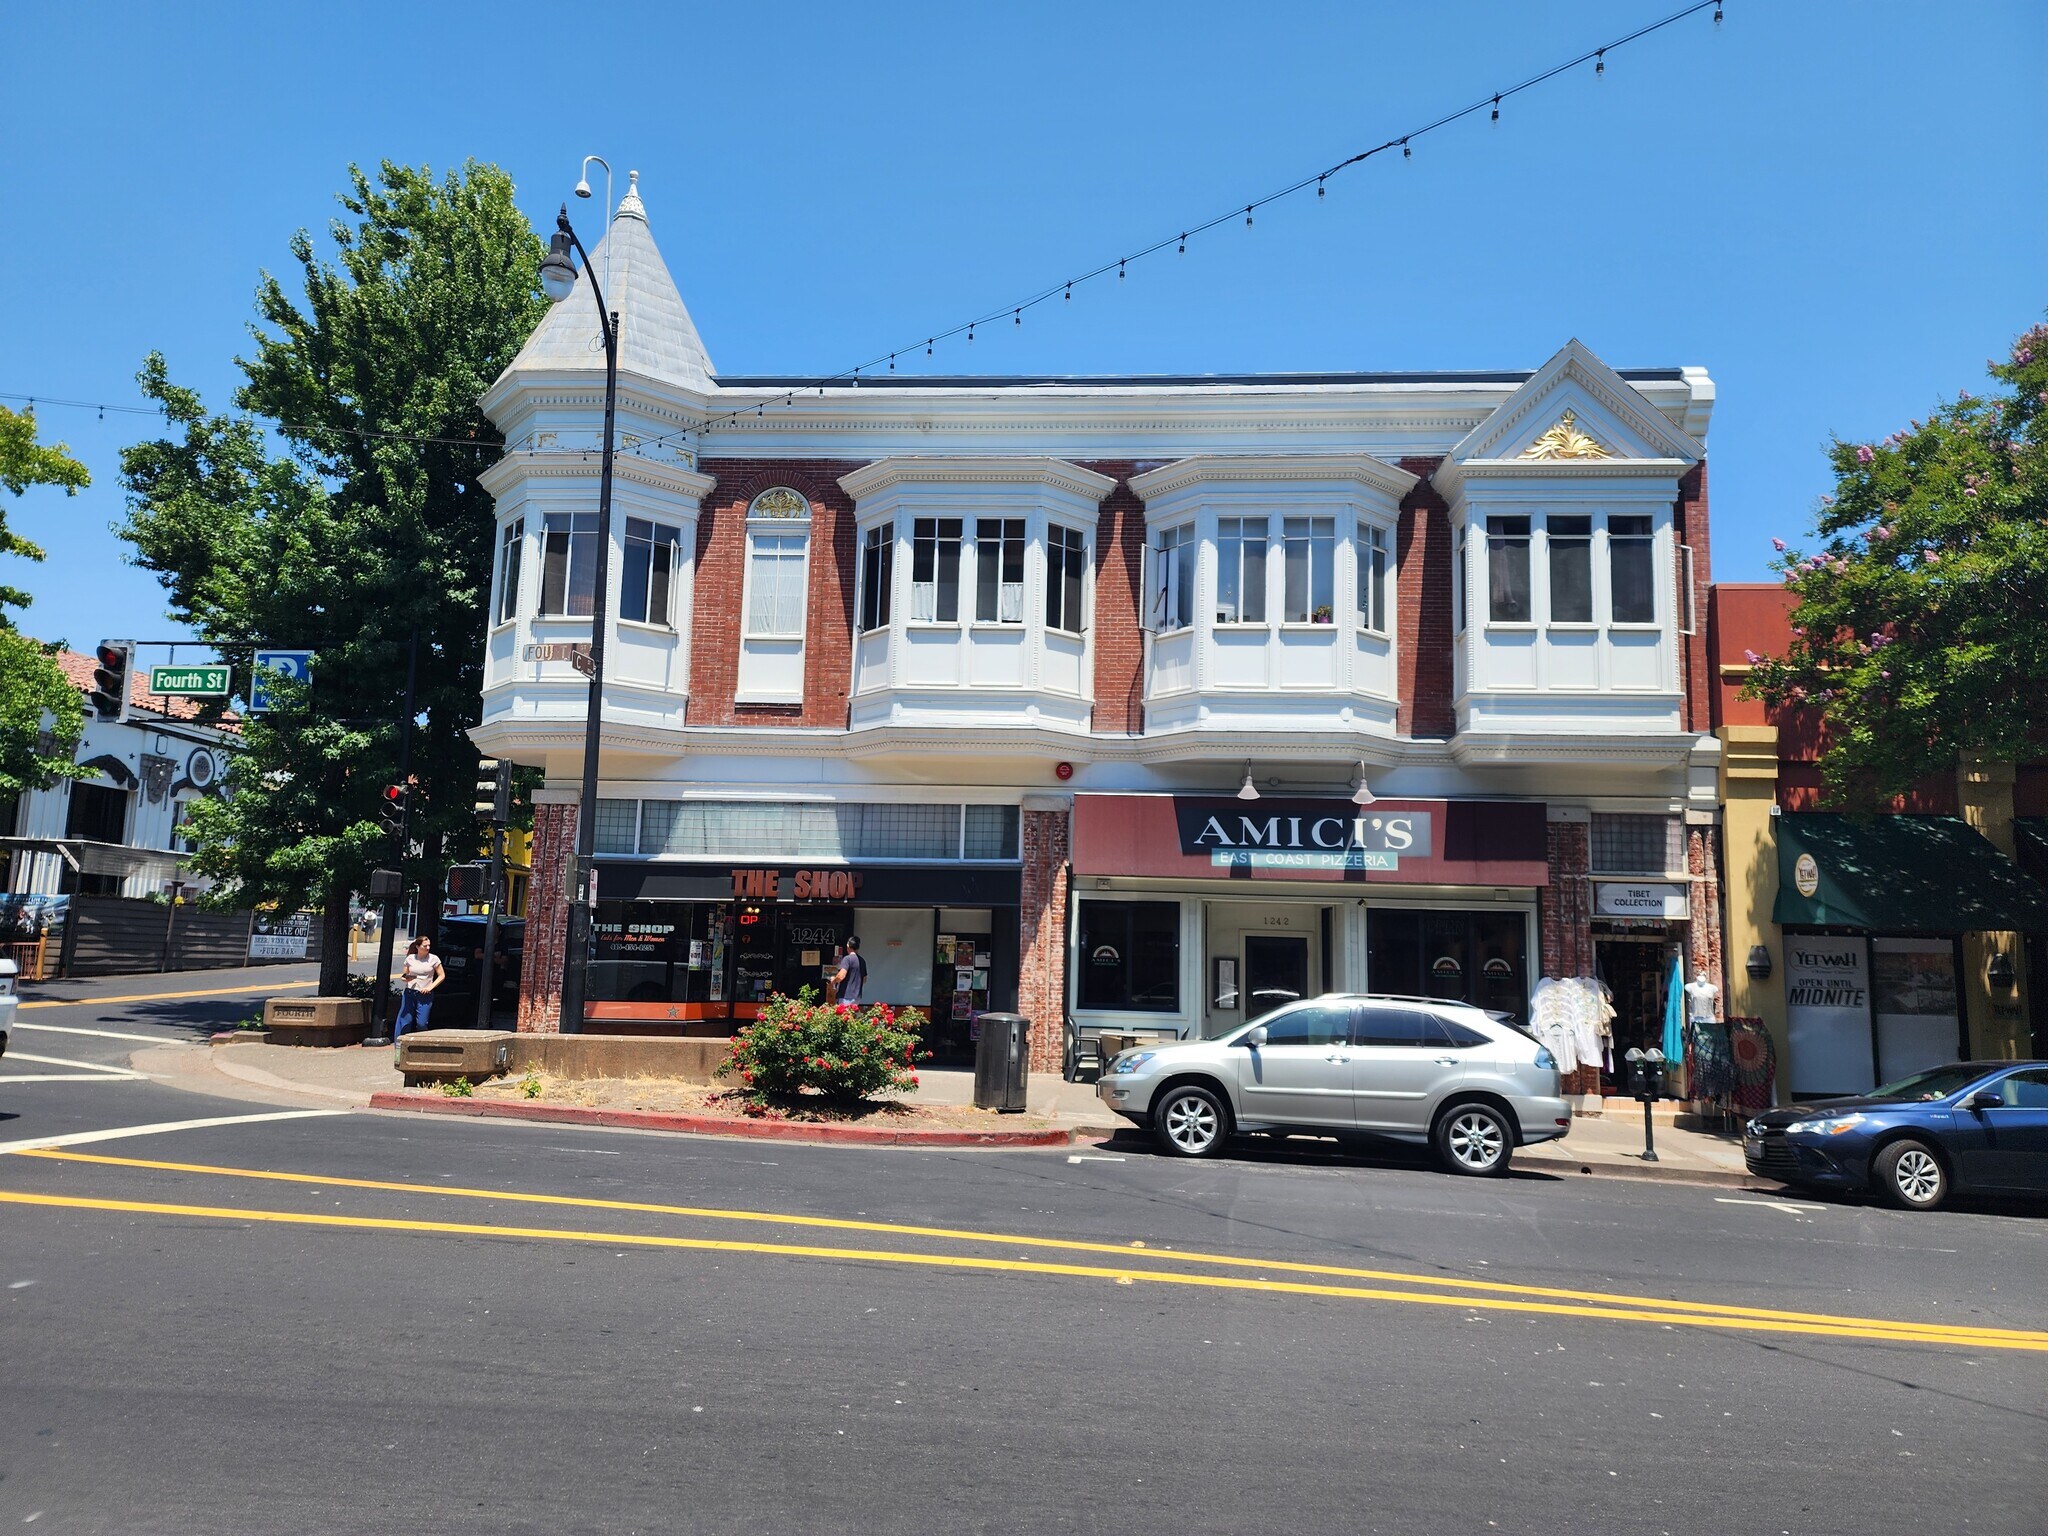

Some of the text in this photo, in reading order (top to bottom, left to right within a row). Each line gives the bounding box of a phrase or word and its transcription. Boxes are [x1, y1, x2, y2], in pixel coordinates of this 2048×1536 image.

[576, 655, 582, 669] C
[156, 672, 223, 688] Fourth St
[1193, 815, 1413, 850] AMICI'S
[1220, 852, 1388, 867] EAST COAST PIZZERIA
[731, 869, 864, 899] THE SHOP
[1627, 889, 1651, 898] TIBET
[1614, 899, 1662, 907] COLLECTION
[1264, 917, 1289, 926] 1242
[273, 926, 308, 937] TAKE OUT
[592, 923, 675, 934] THE SHOP
[623, 934, 637, 942] Men
[638, 934, 644, 942] &
[792, 928, 835, 944] 1244
[1799, 979, 1853, 988] OPEN UNTIL
[1789, 989, 1864, 1006] MIDNITE
[276, 1010, 313, 1018] FOURTH
